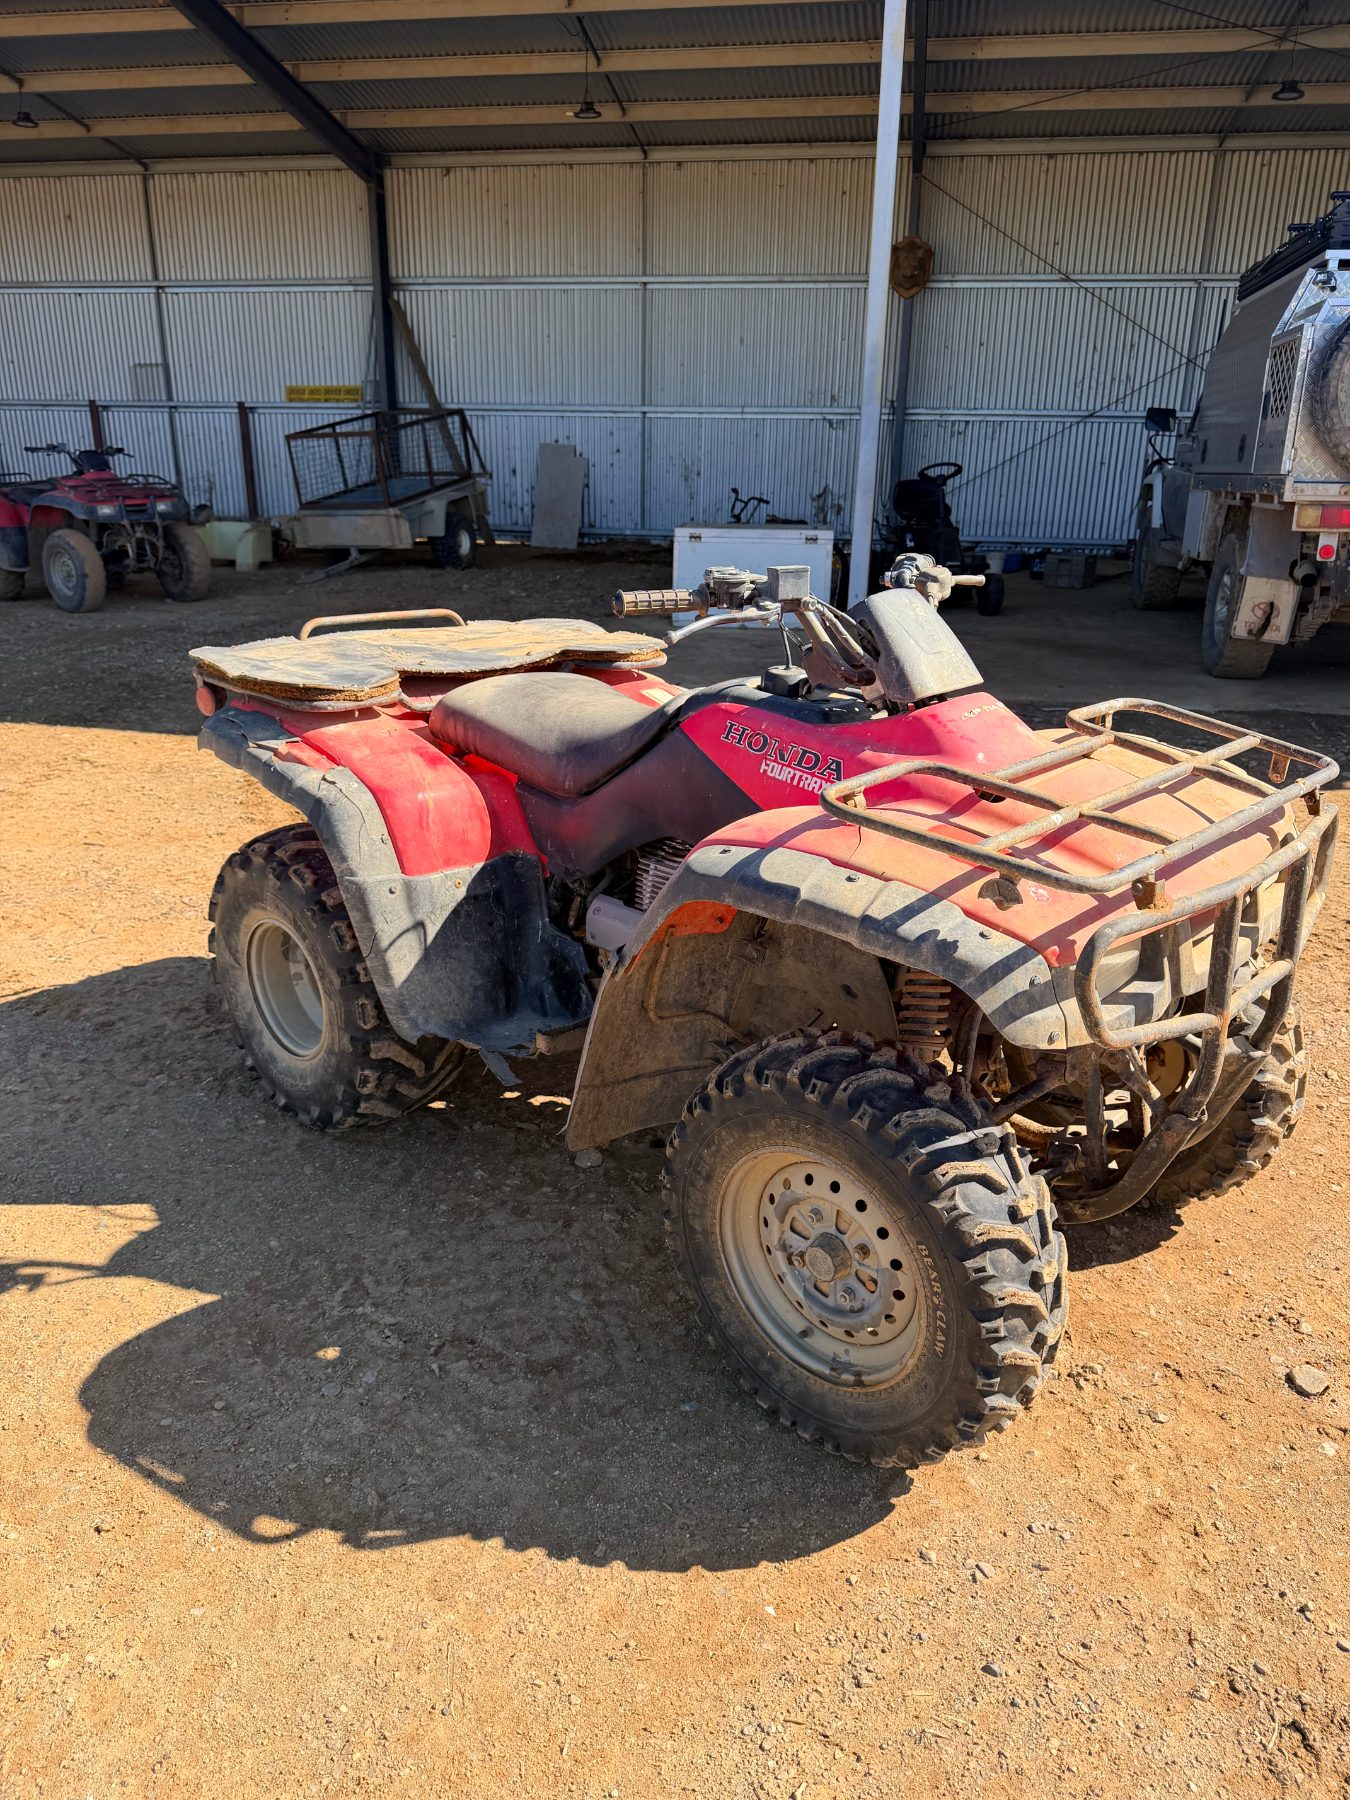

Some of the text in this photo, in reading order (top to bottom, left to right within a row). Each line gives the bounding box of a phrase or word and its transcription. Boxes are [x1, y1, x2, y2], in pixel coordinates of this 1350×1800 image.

[1244, 620, 1281, 633] TOTA
[720, 720, 844, 782] HONDA
[917, 1244, 946, 1358] BEAR CLAW
